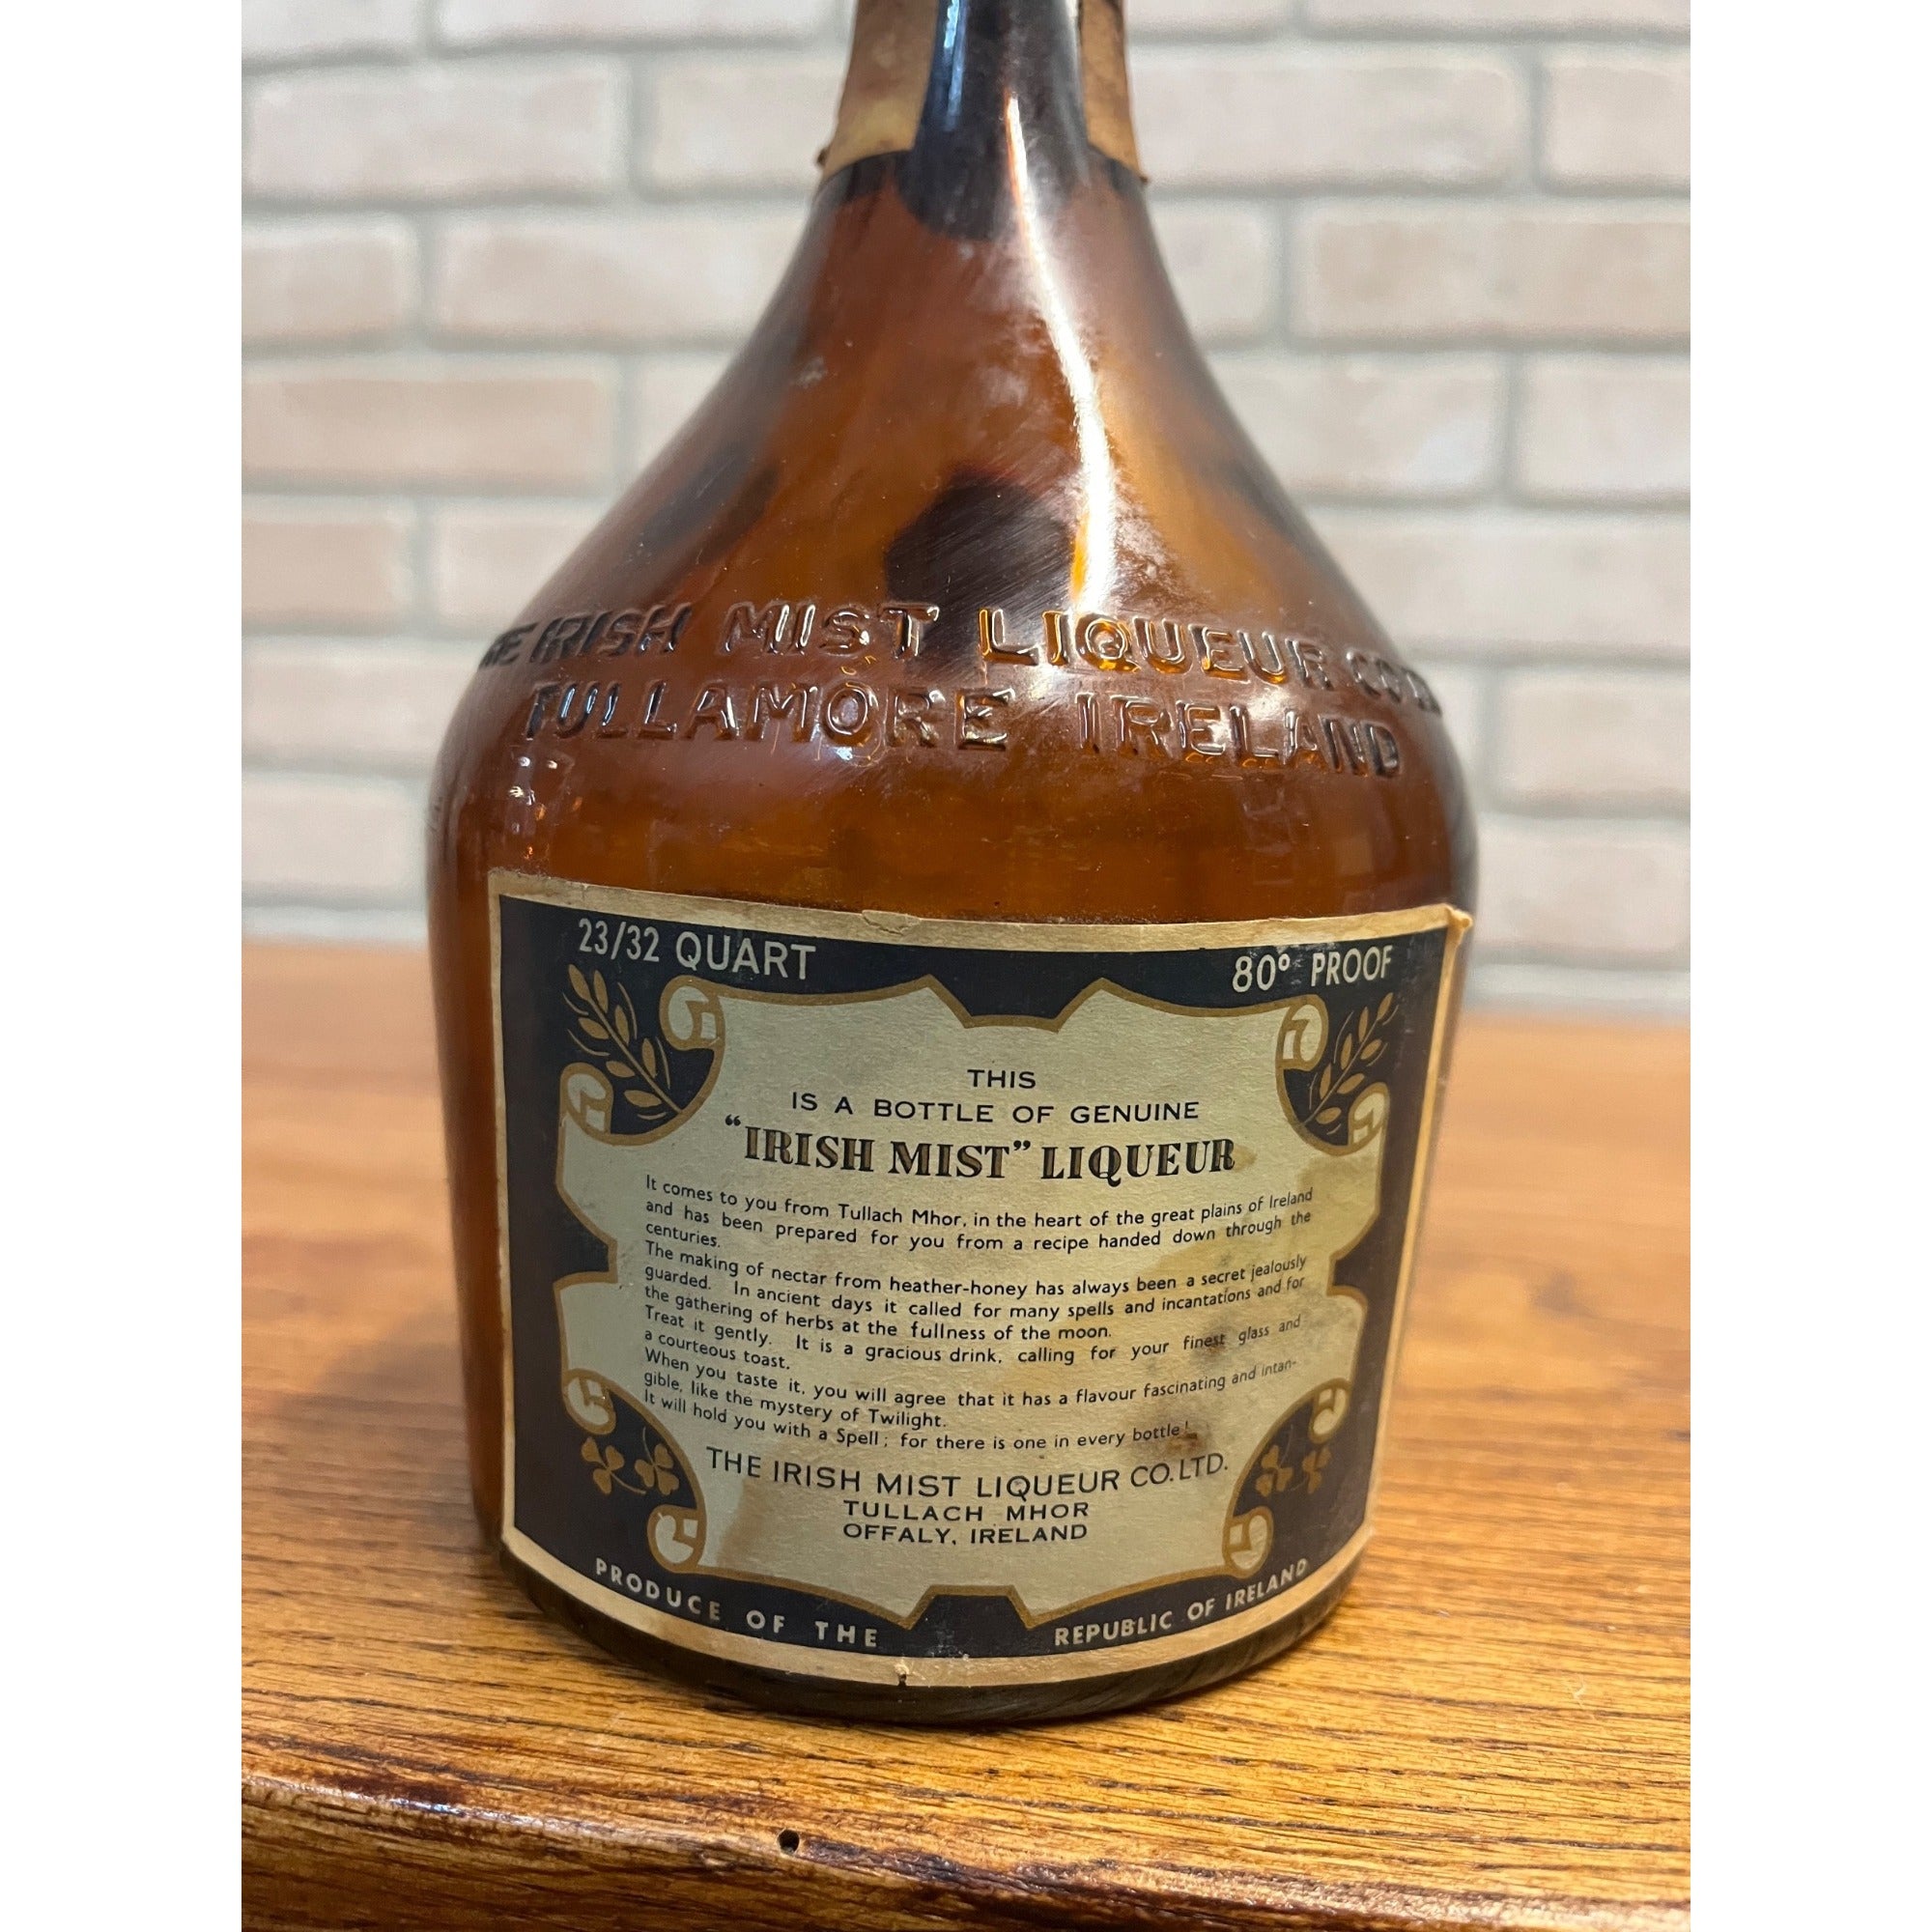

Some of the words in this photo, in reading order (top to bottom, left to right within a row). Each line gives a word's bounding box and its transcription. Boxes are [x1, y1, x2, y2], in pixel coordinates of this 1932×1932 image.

[529, 601, 693, 664] IRISH
[720, 601, 940, 659] MIST
[978, 607, 1336, 690] LIQUEUR
[525, 678, 1016, 752] TULLAMORE
[1074, 691, 1402, 779] IRELAND
[578, 917, 661, 962] 23/32
[675, 930, 817, 980] QUART
[1311, 946, 1393, 987] PROOF
[967, 1068, 1037, 1089] THIS
[791, 1092, 819, 1111] IS
[834, 1096, 855, 1115] A
[874, 1100, 993, 1123] BOTTLE
[1012, 1105, 1052, 1123] OF
[1069, 1101, 1200, 1123] GENUINE
[1040, 1138, 1236, 1187] LIQUEUR
[646, 1175, 657, 1191] It
[663, 1182, 713, 1202] comes
[720, 1191, 737, 1206] to
[745, 1195, 778, 1212] you
[784, 1198, 829, 1217] from
[838, 1204, 902, 1223] Tullach
[974, 1212, 990, 1227] in
[996, 1212, 1027, 1228] the
[1035, 1212, 1082, 1228] heart
[1090, 1210, 1110, 1226] of
[1117, 1209, 1145, 1226] the
[1151, 1207, 1195, 1228] great
[1201, 1204, 1242, 1224] plains
[1248, 1199, 1264, 1212] of
[1269, 1186, 1313, 1208] Ireland
[646, 1202, 672, 1215] and
[684, 1206, 709, 1224] has
[723, 1211, 763, 1233] been
[776, 1223, 857, 1243] prepared
[871, 1230, 898, 1245] for
[909, 1236, 944, 1252] you
[957, 1234, 1004, 1250] from
[1013, 1240, 1023, 1250] a
[1034, 1236, 1089, 1254] recipe
[1098, 1230, 1161, 1248] handed
[1173, 1229, 1215, 1244] down
[1226, 1215, 1282, 1238] through
[1291, 1209, 1312, 1227] the
[646, 1222, 721, 1248] centuries.
[645, 1240, 673, 1260] The
[680, 1252, 739, 1277] making
[746, 1263, 764, 1276] of
[772, 1268, 828, 1285] nectar
[836, 1272, 881, 1291] from
[890, 1276, 1028, 1300] heather-honey
[1036, 1281, 1065, 1295] has
[1072, 1279, 1129, 1296] always
[1137, 1277, 1177, 1293] been
[1186, 1278, 1195, 1288] a
[1201, 1268, 1246, 1286] secret
[1251, 1254, 1307, 1283] jealously
[645, 1265, 712, 1291] guarded.
[734, 1281, 750, 1296] In
[757, 1290, 821, 1307] ancient
[832, 1294, 872, 1315] days
[885, 1299, 896, 1313] it
[909, 1301, 961, 1317] called
[974, 1302, 1002, 1318] for
[1010, 1306, 1060, 1322] many
[1067, 1301, 1114, 1321] spells
[1124, 1297, 1154, 1315] and
[1162, 1287, 1251, 1311] incantations
[1258, 1279, 1281, 1297] and
[1287, 1276, 1304, 1292] for
[645, 1286, 669, 1302] the
[676, 1295, 753, 1323] gathering
[760, 1309, 779, 1322] of
[786, 1311, 834, 1331] herbs
[841, 1321, 860, 1333] at
[867, 1321, 897, 1336] the
[911, 1321, 985, 1340] fullness
[994, 1325, 1013, 1340] of
[1021, 1324, 1051, 1340] the
[1058, 1326, 1112, 1340] moon.
[645, 1305, 684, 1328] Treat
[694, 1318, 704, 1332] it
[715, 1324, 772, 1348] gently.
[796, 1334, 809, 1350] It
[820, 1338, 833, 1353] is
[843, 1344, 854, 1355] a
[866, 1347, 942, 1362] gracious
[1017, 1348, 1075, 1366] calling
[1091, 1346, 1116, 1360] for
[1130, 1341, 1169, 1361] your
[1183, 1333, 1225, 1350] finest
[1238, 1325, 1269, 1345] glass
[1279, 1314, 1301, 1332] and
[645, 1330, 653, 1341] a
[659, 1334, 736, 1361] courteous
[744, 1350, 790, 1370] toast.
[645, 1347, 689, 1372] When
[696, 1365, 726, 1380] you
[737, 1371, 779, 1389] taste
[813, 1385, 847, 1400] you
[855, 1388, 887, 1403] will
[895, 1393, 946, 1408] agree
[957, 1391, 995, 1406] that
[1003, 1392, 1014, 1406] it
[1022, 1391, 1051, 1406] has
[1059, 1395, 1068, 1406] a
[1076, 1388, 1137, 1404] flavour
[1144, 1376, 1226, 1398] fascinating
[1232, 1367, 1257, 1384] and
[1261, 1358, 1297, 1377] intan-
[644, 1389, 655, 1405] It
[661, 1396, 686, 1414] will
[694, 1402, 727, 1423] hold
[734, 1414, 766, 1431] you
[774, 1421, 810, 1438] with
[818, 1428, 828, 1440] a
[900, 1433, 928, 1447] for
[936, 1435, 985, 1450] there
[993, 1435, 1005, 1450] is
[1013, 1438, 1046, 1450] one
[1054, 1435, 1069, 1448] in
[1077, 1431, 1125, 1448] every
[691, 1381, 719, 1400] like
[725, 1389, 753, 1406] the
[760, 1400, 833, 1422] mystery
[840, 1407, 860, 1422] of
[867, 1408, 947, 1431] Twilight.
[705, 1447, 761, 1478] THE
[774, 1459, 861, 1492] IRISH
[876, 1473, 961, 1497] MIST
[977, 1468, 1120, 1502] LIQUEUR
[843, 1499, 983, 1522] TULLACH
[1007, 1500, 1089, 1520] MHOR
[970, 1522, 1088, 1545] IRELAND
[595, 1557, 721, 1621] PRODUCE
[746, 1609, 785, 1634] OF
[814, 1620, 878, 1648] THE
[1054, 1610, 1172, 1646] REPUBLIC
[1186, 1597, 1215, 1621] OF
[1225, 1557, 1309, 1611] IRELAND
